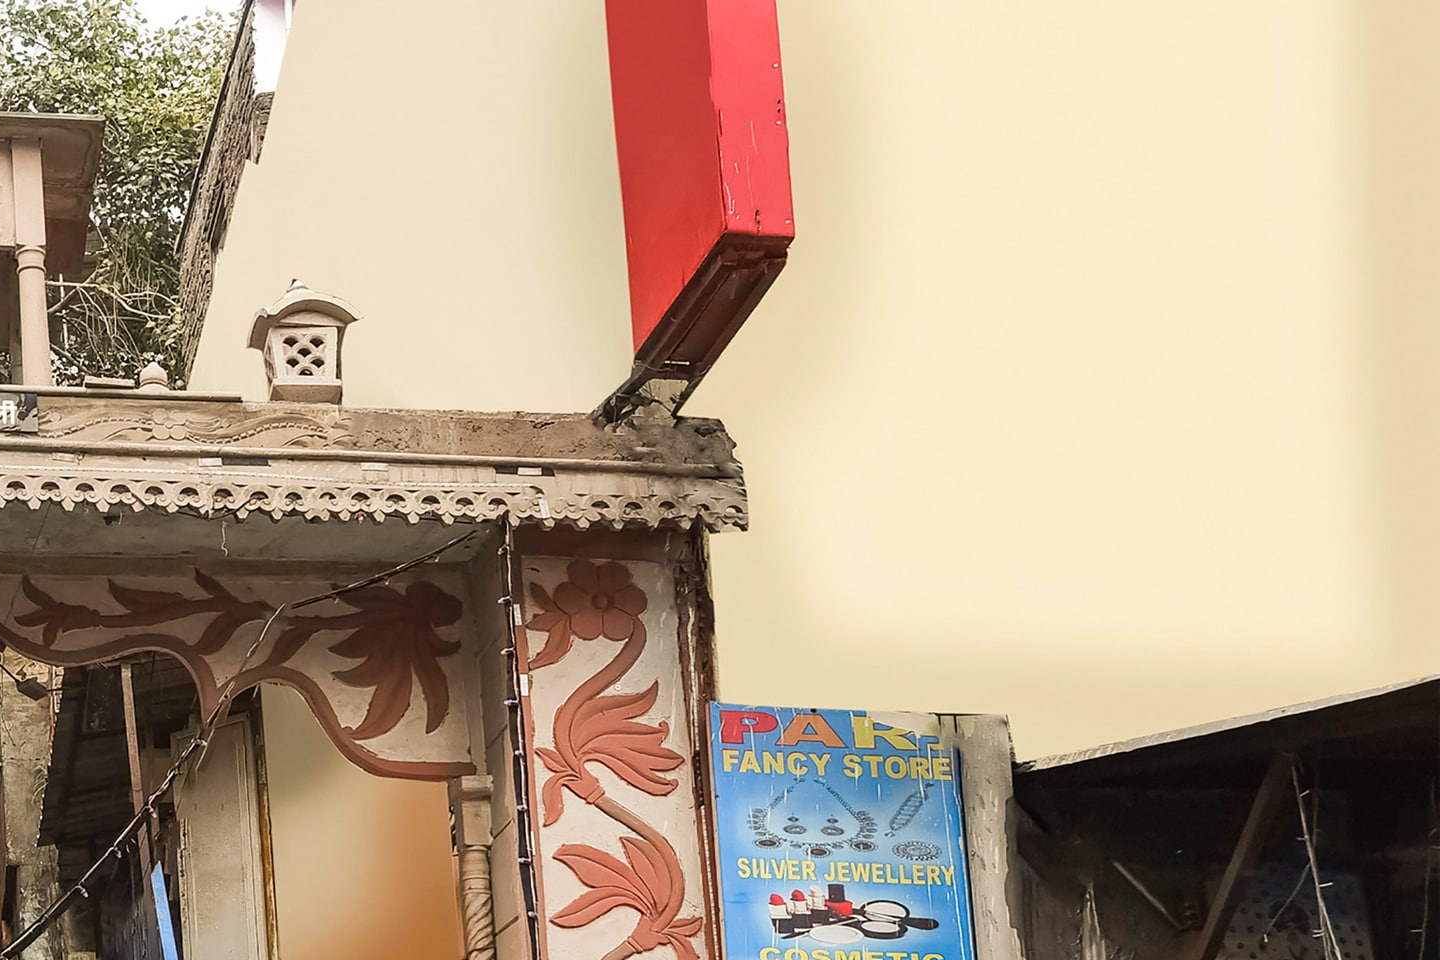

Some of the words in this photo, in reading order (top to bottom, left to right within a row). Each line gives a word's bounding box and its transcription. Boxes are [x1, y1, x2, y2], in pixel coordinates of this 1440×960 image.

[720, 710, 943, 751] PAR
[722, 749, 831, 776] FANCY
[843, 754, 953, 781] STORE
[737, 857, 816, 881] SILVER
[824, 861, 955, 886] JEWELLERY
